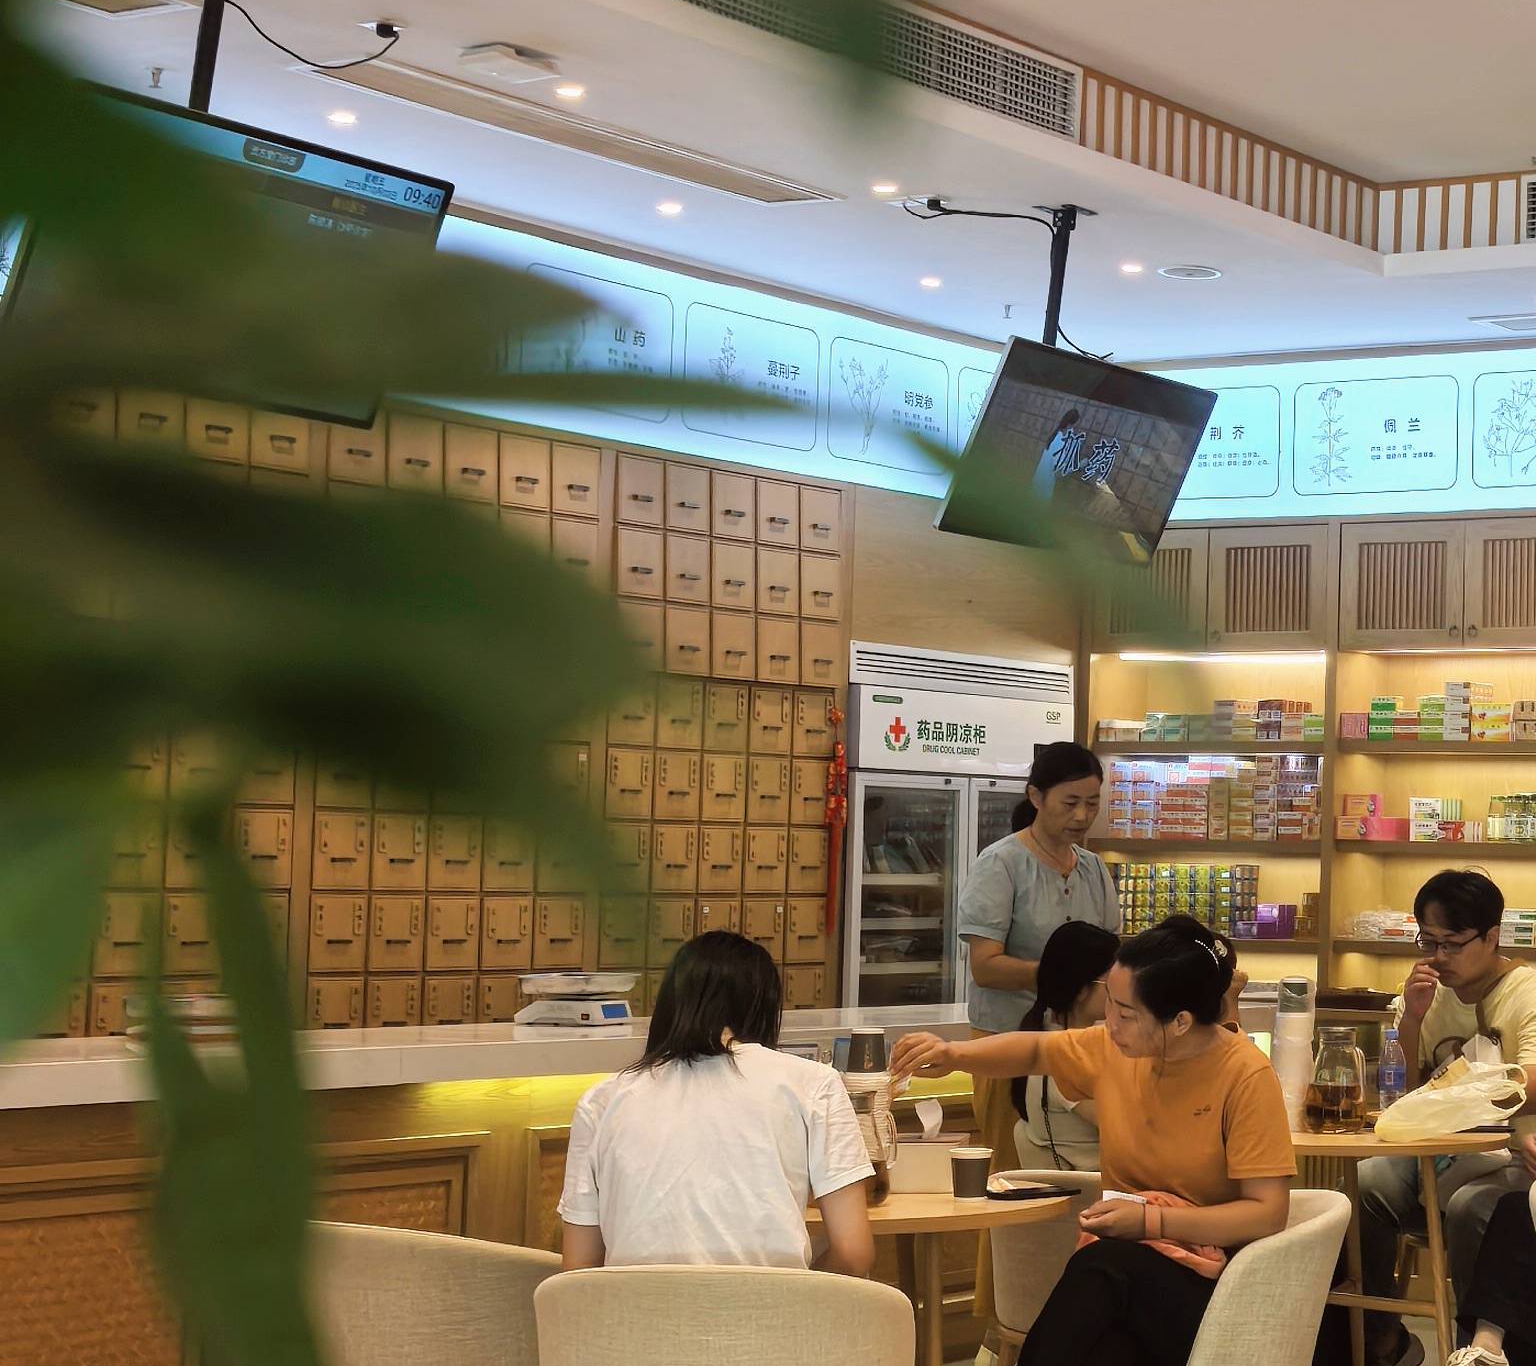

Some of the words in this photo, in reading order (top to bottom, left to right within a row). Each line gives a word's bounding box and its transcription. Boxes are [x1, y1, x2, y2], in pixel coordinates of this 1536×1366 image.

[403, 186, 442, 210] 09:40
[917, 719, 987, 744] 药品阴凉柜
[922, 745, 939, 753] DRUG
[957, 747, 980, 756] CABINET
